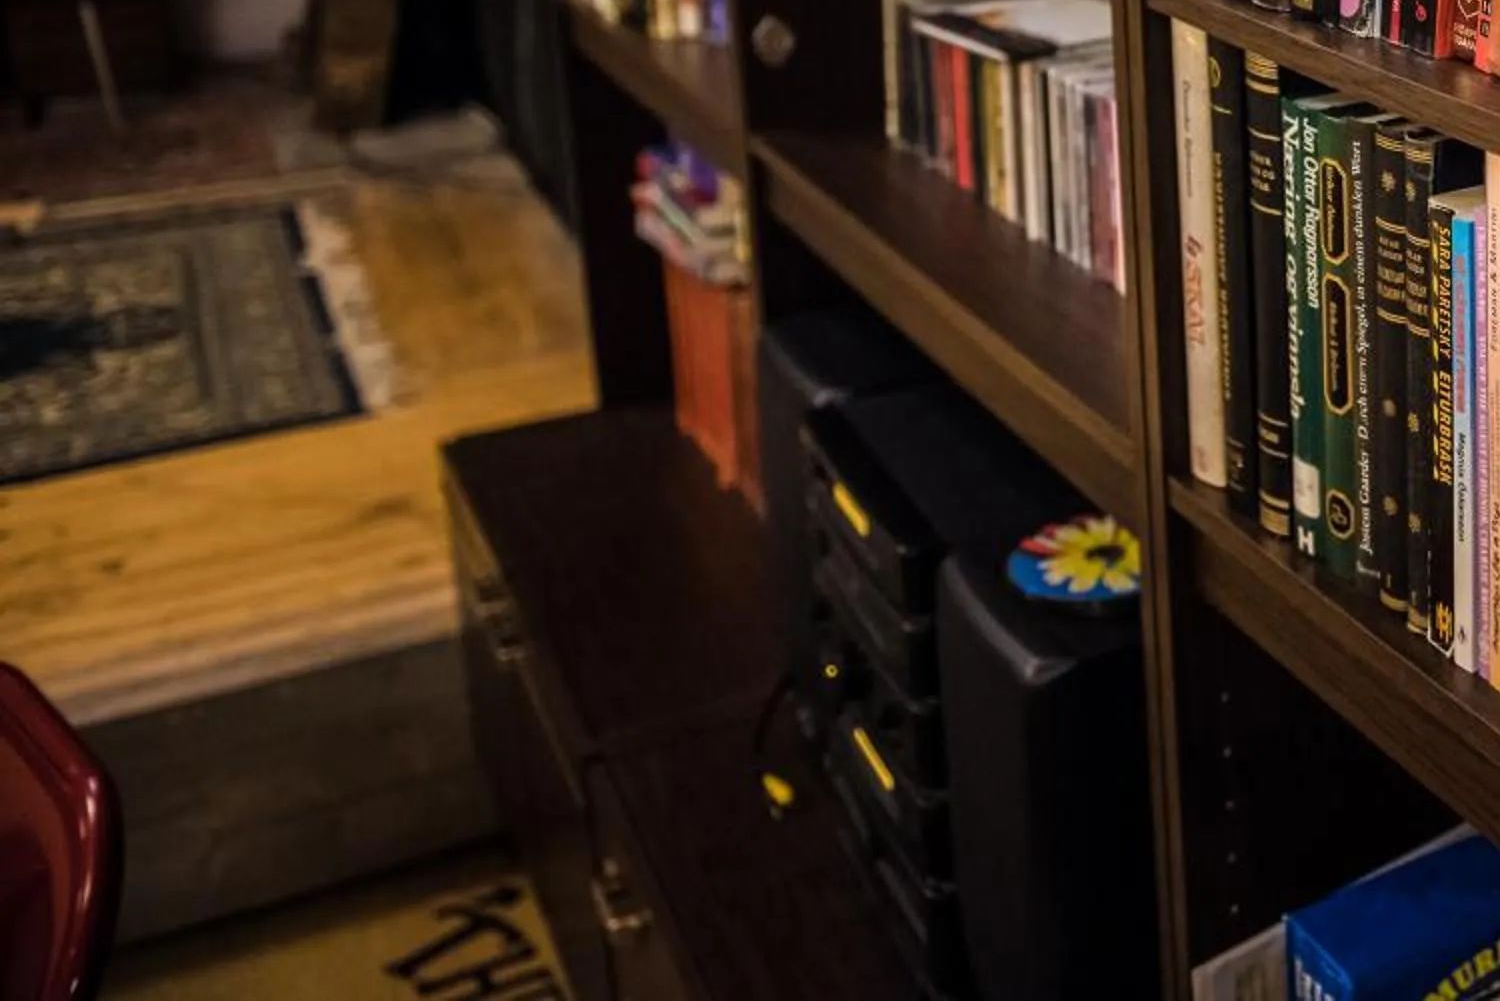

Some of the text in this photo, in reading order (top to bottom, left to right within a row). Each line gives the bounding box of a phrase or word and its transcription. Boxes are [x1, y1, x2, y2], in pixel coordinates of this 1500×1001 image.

[1282, 109, 1301, 245] Næring
[1303, 204, 1321, 310] Ragnarsson
[1438, 225, 1451, 270] SARA
[1438, 275, 1451, 360] PARETSKY
